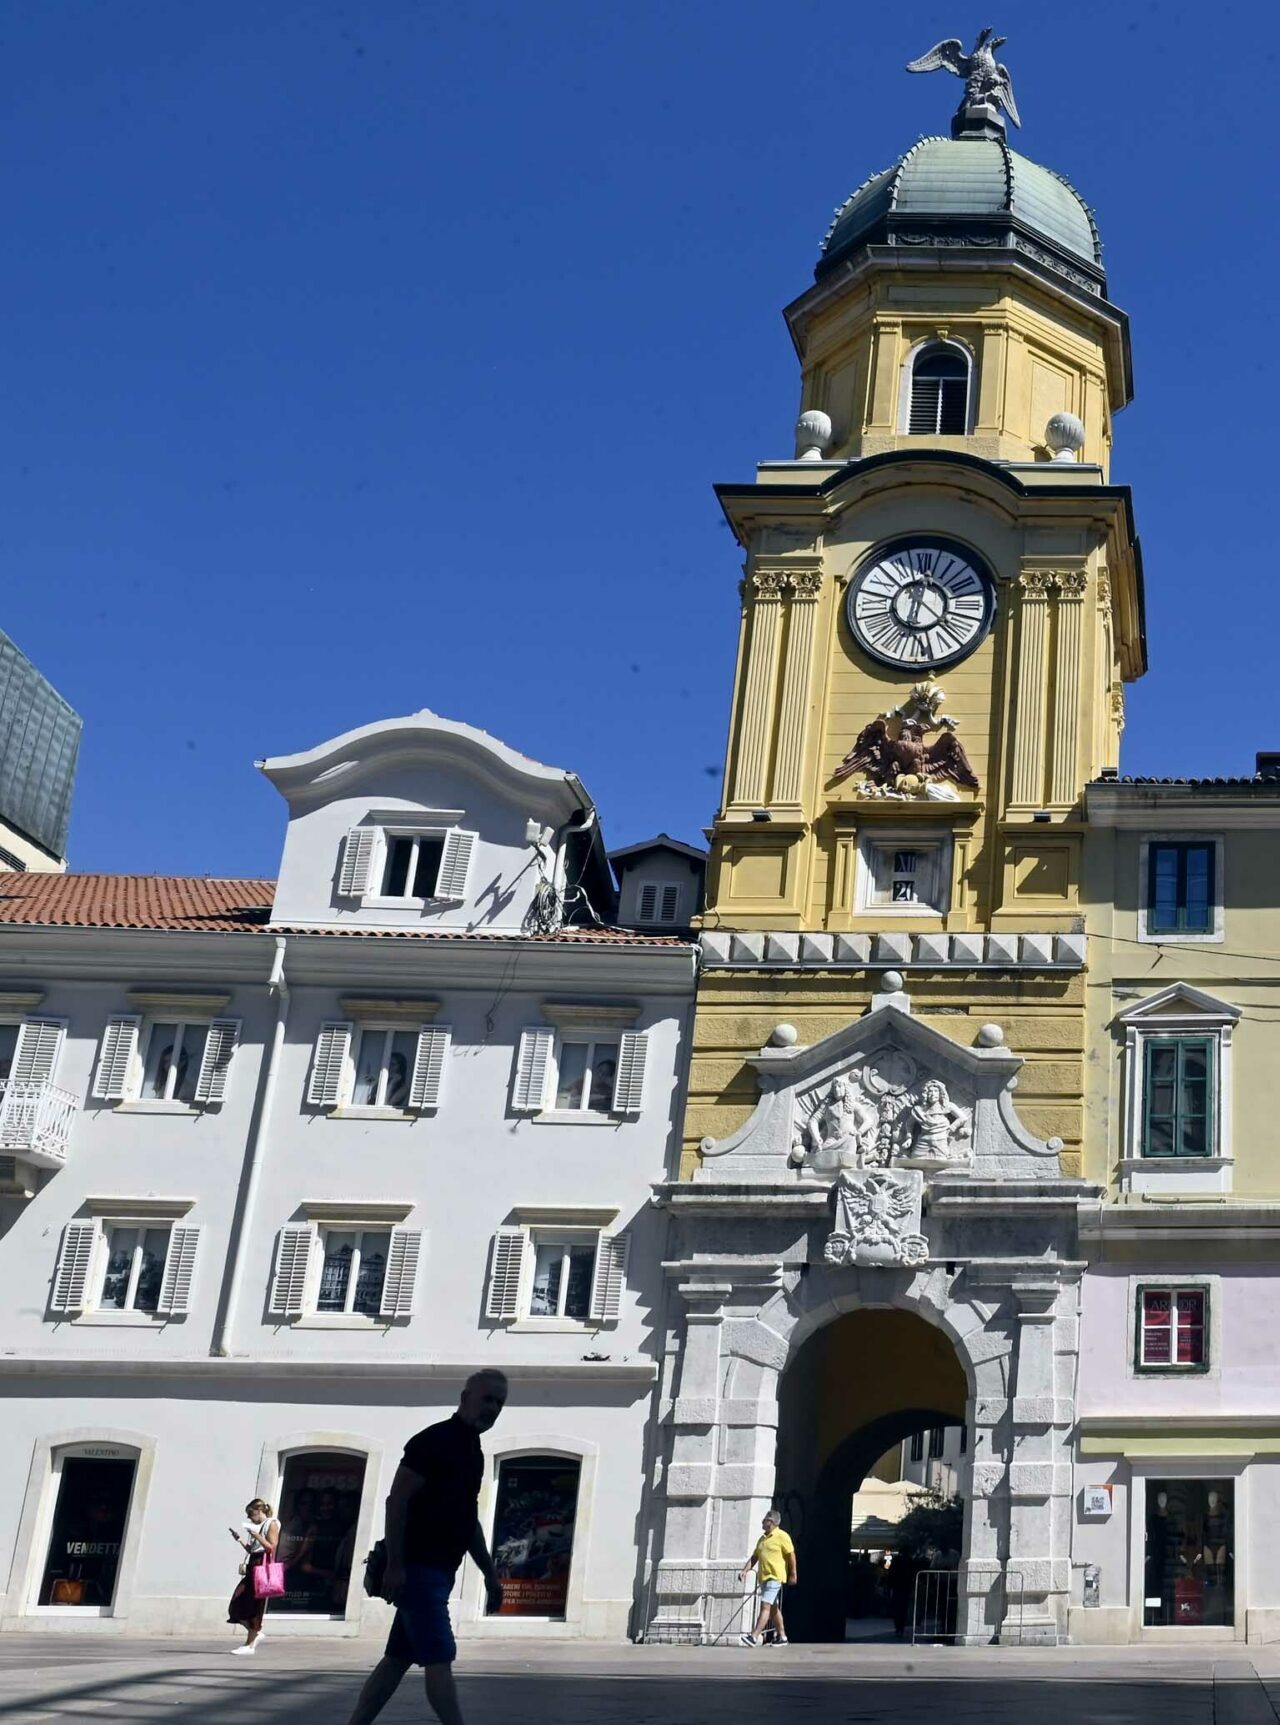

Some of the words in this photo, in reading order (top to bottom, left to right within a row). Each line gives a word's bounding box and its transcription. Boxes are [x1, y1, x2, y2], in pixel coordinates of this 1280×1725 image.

[891, 558, 910, 581] XI
[870, 575, 895, 592] X
[950, 576, 975, 593] II
[862, 597, 888, 611] IX
[955, 600, 981, 611] III
[935, 631, 953, 653] V
[307, 1475, 359, 1489] BOSS
